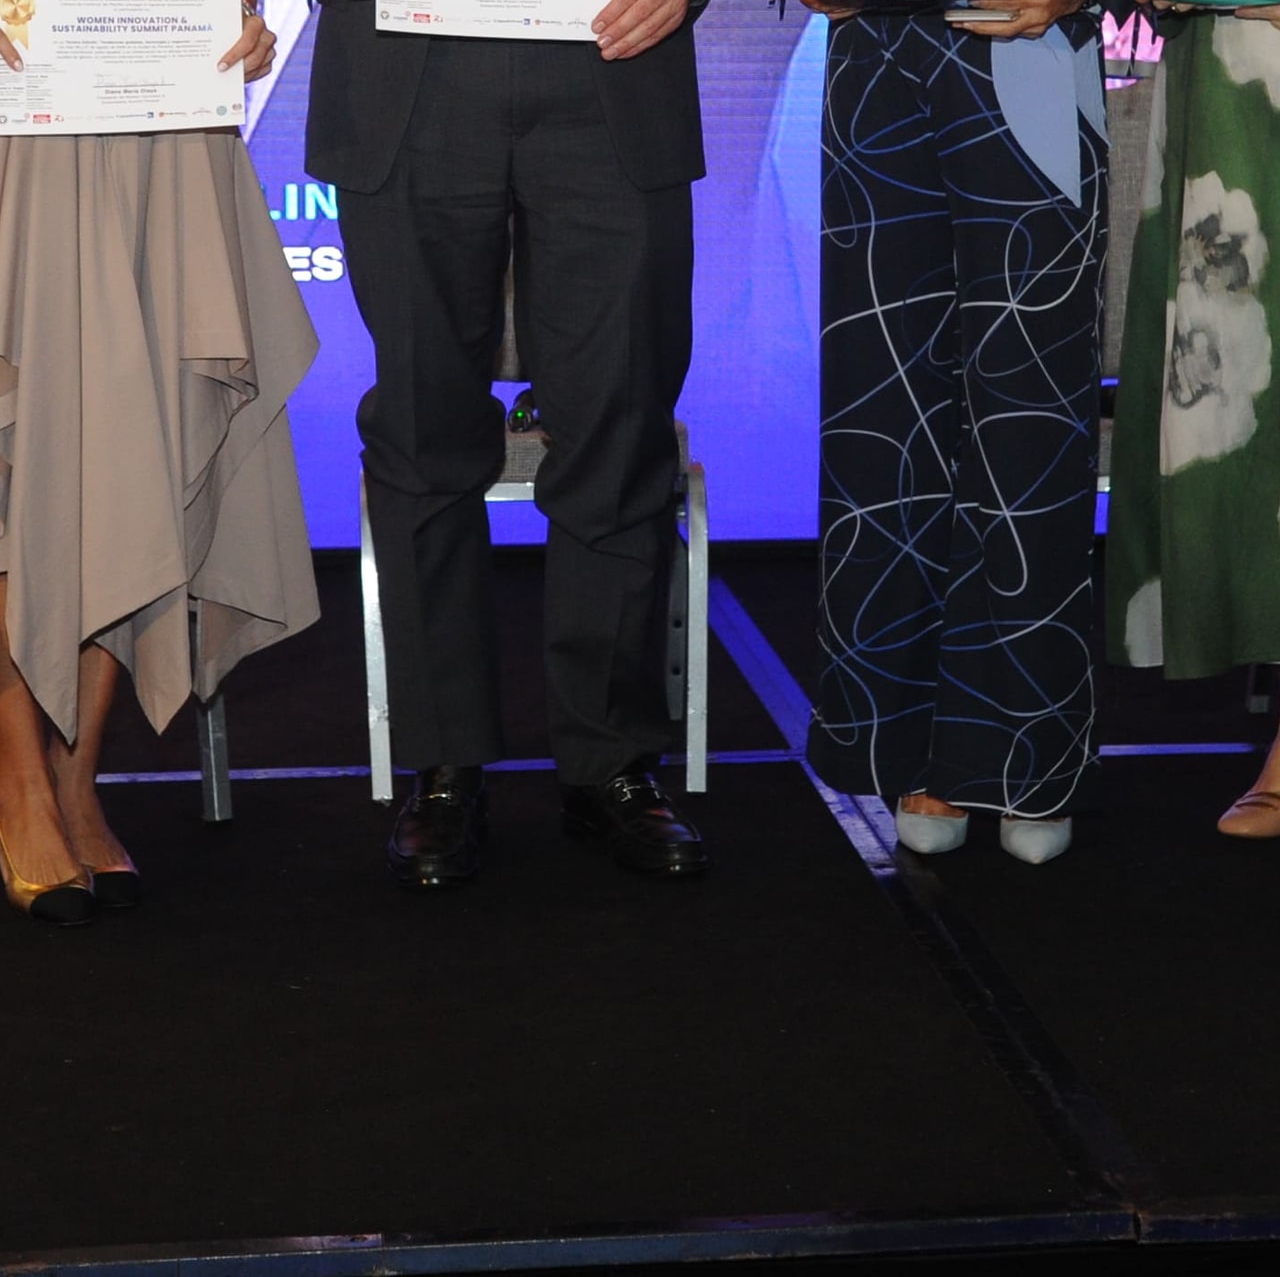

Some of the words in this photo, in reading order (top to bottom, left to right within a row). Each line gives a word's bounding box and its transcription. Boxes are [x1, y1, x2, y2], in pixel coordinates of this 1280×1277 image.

[77, 16, 115, 24] WOMEN
[117, 16, 178, 24] INNOVATION
[52, 24, 128, 33] SUSTAINABILITY
[131, 24, 168, 33] SUMMIT
